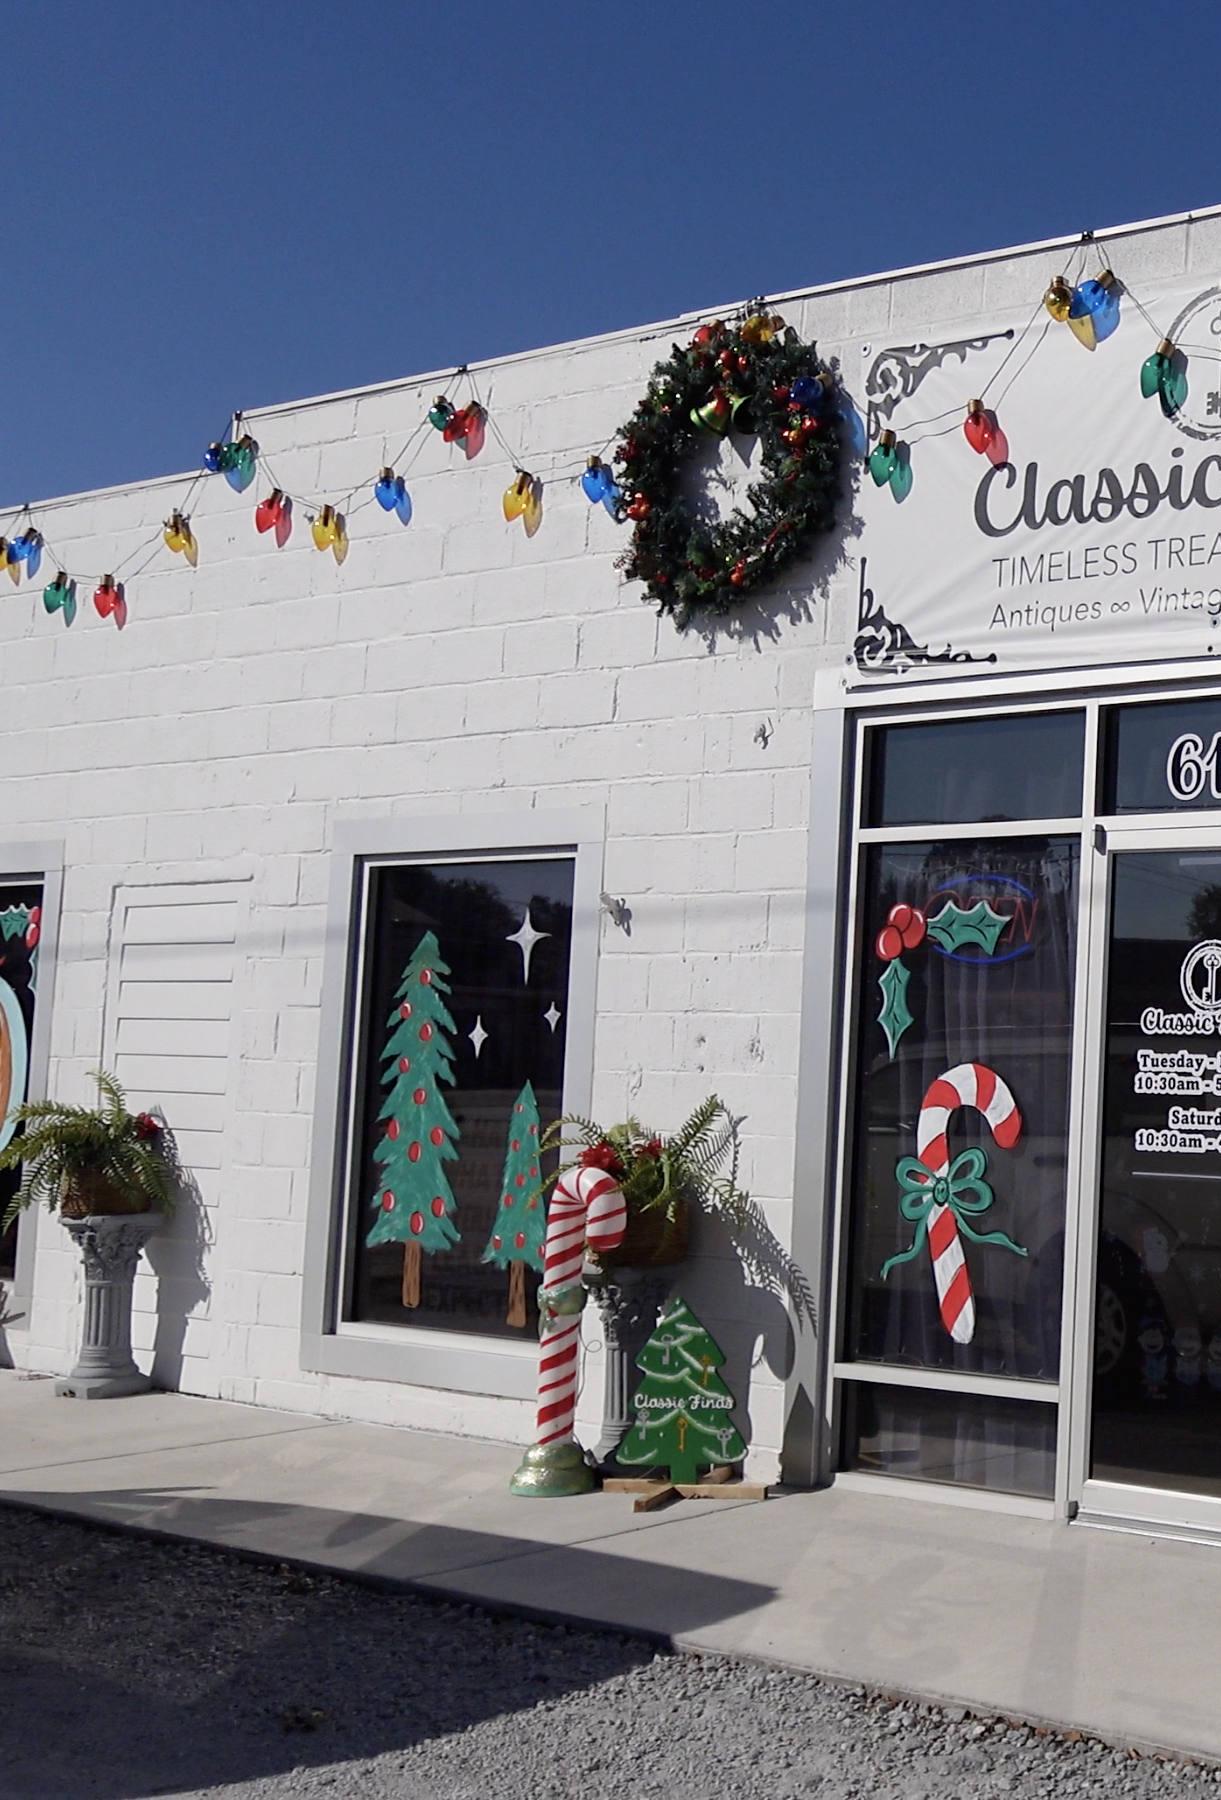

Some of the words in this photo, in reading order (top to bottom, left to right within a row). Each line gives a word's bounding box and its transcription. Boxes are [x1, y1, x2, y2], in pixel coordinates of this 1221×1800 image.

[992, 543, 1137, 588] TIMELESS
[988, 600, 1103, 631] Antiques
[1141, 1008, 1213, 1033] Classic
[1139, 1053, 1205, 1072] Tuesday
[1136, 1075, 1200, 1091] 10:30am
[1137, 1132, 1203, 1149] 10:30am
[634, 1393, 686, 1409] Classic
[689, 1394, 734, 1410] Finds
